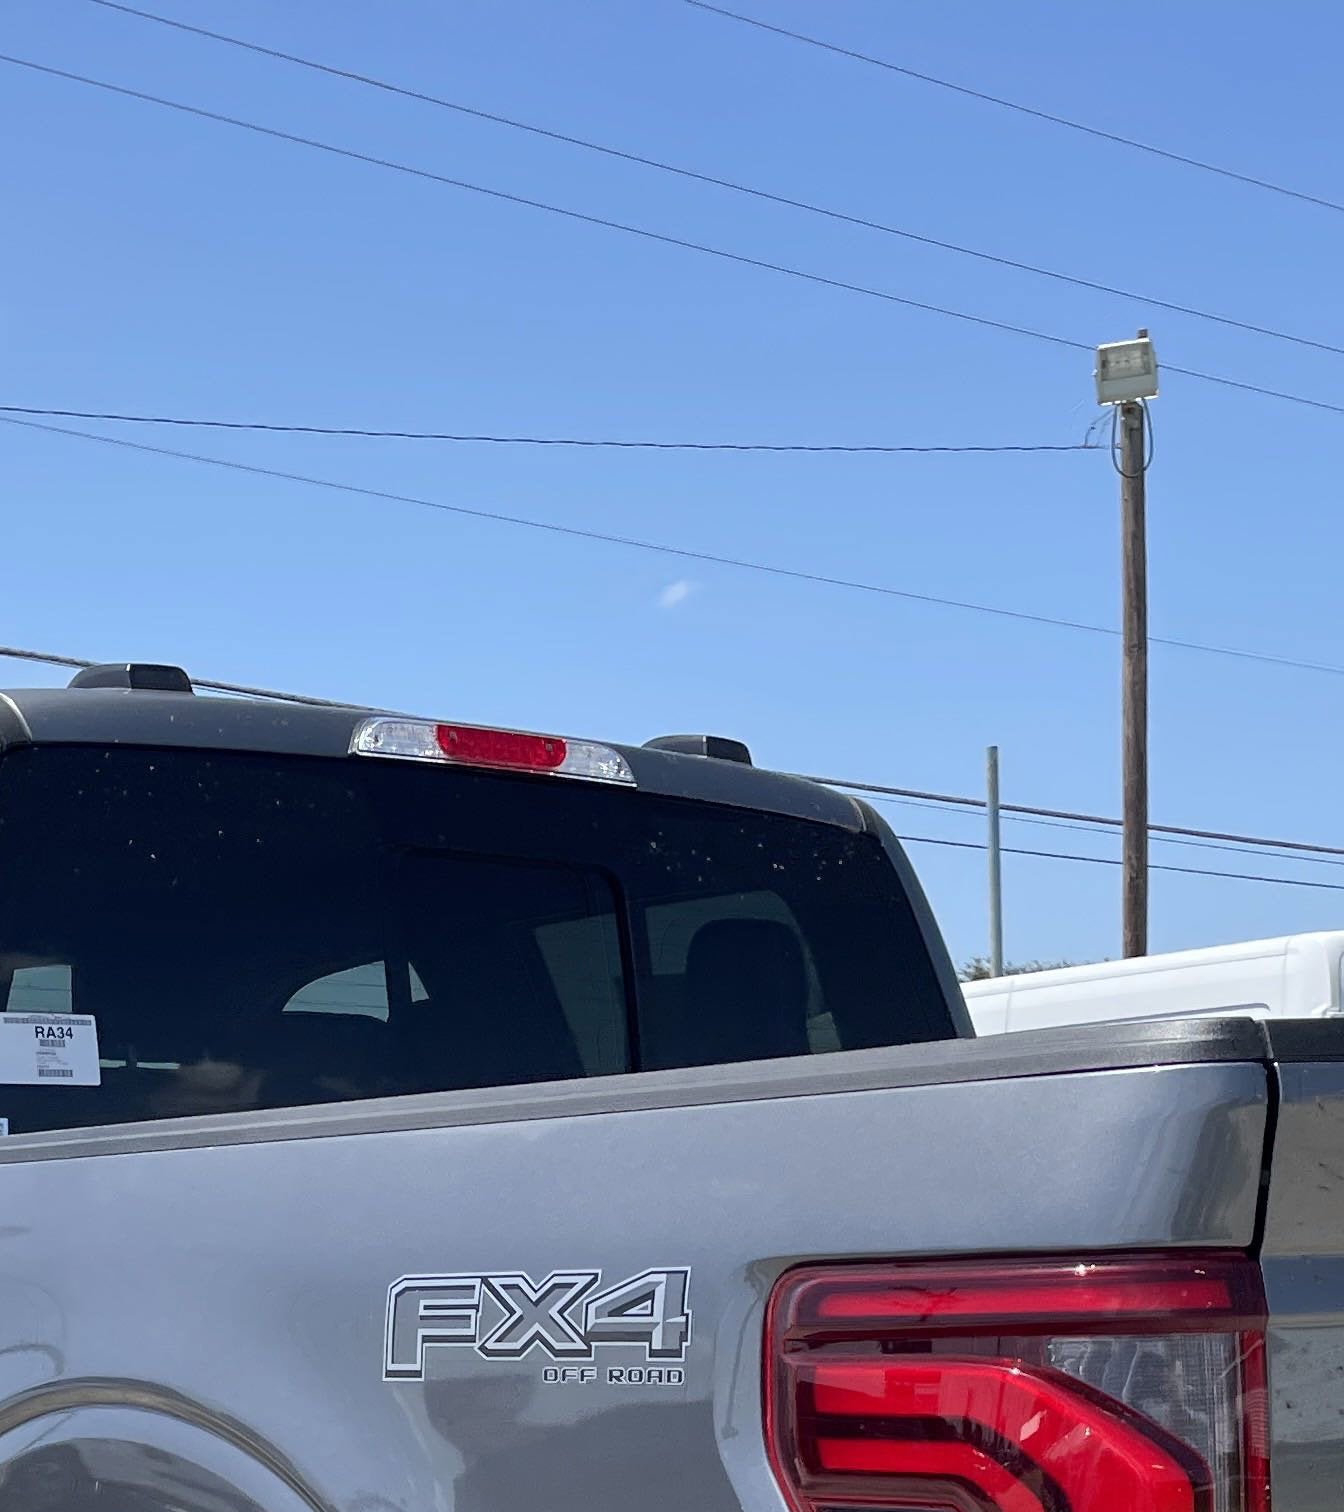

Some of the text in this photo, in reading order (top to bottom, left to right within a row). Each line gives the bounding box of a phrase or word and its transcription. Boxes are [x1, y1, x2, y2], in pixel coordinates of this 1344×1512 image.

[35, 1026, 74, 1040] RA34
[383, 1266, 692, 1382] FX4
[542, 1366, 685, 1386] OFF ROAD
